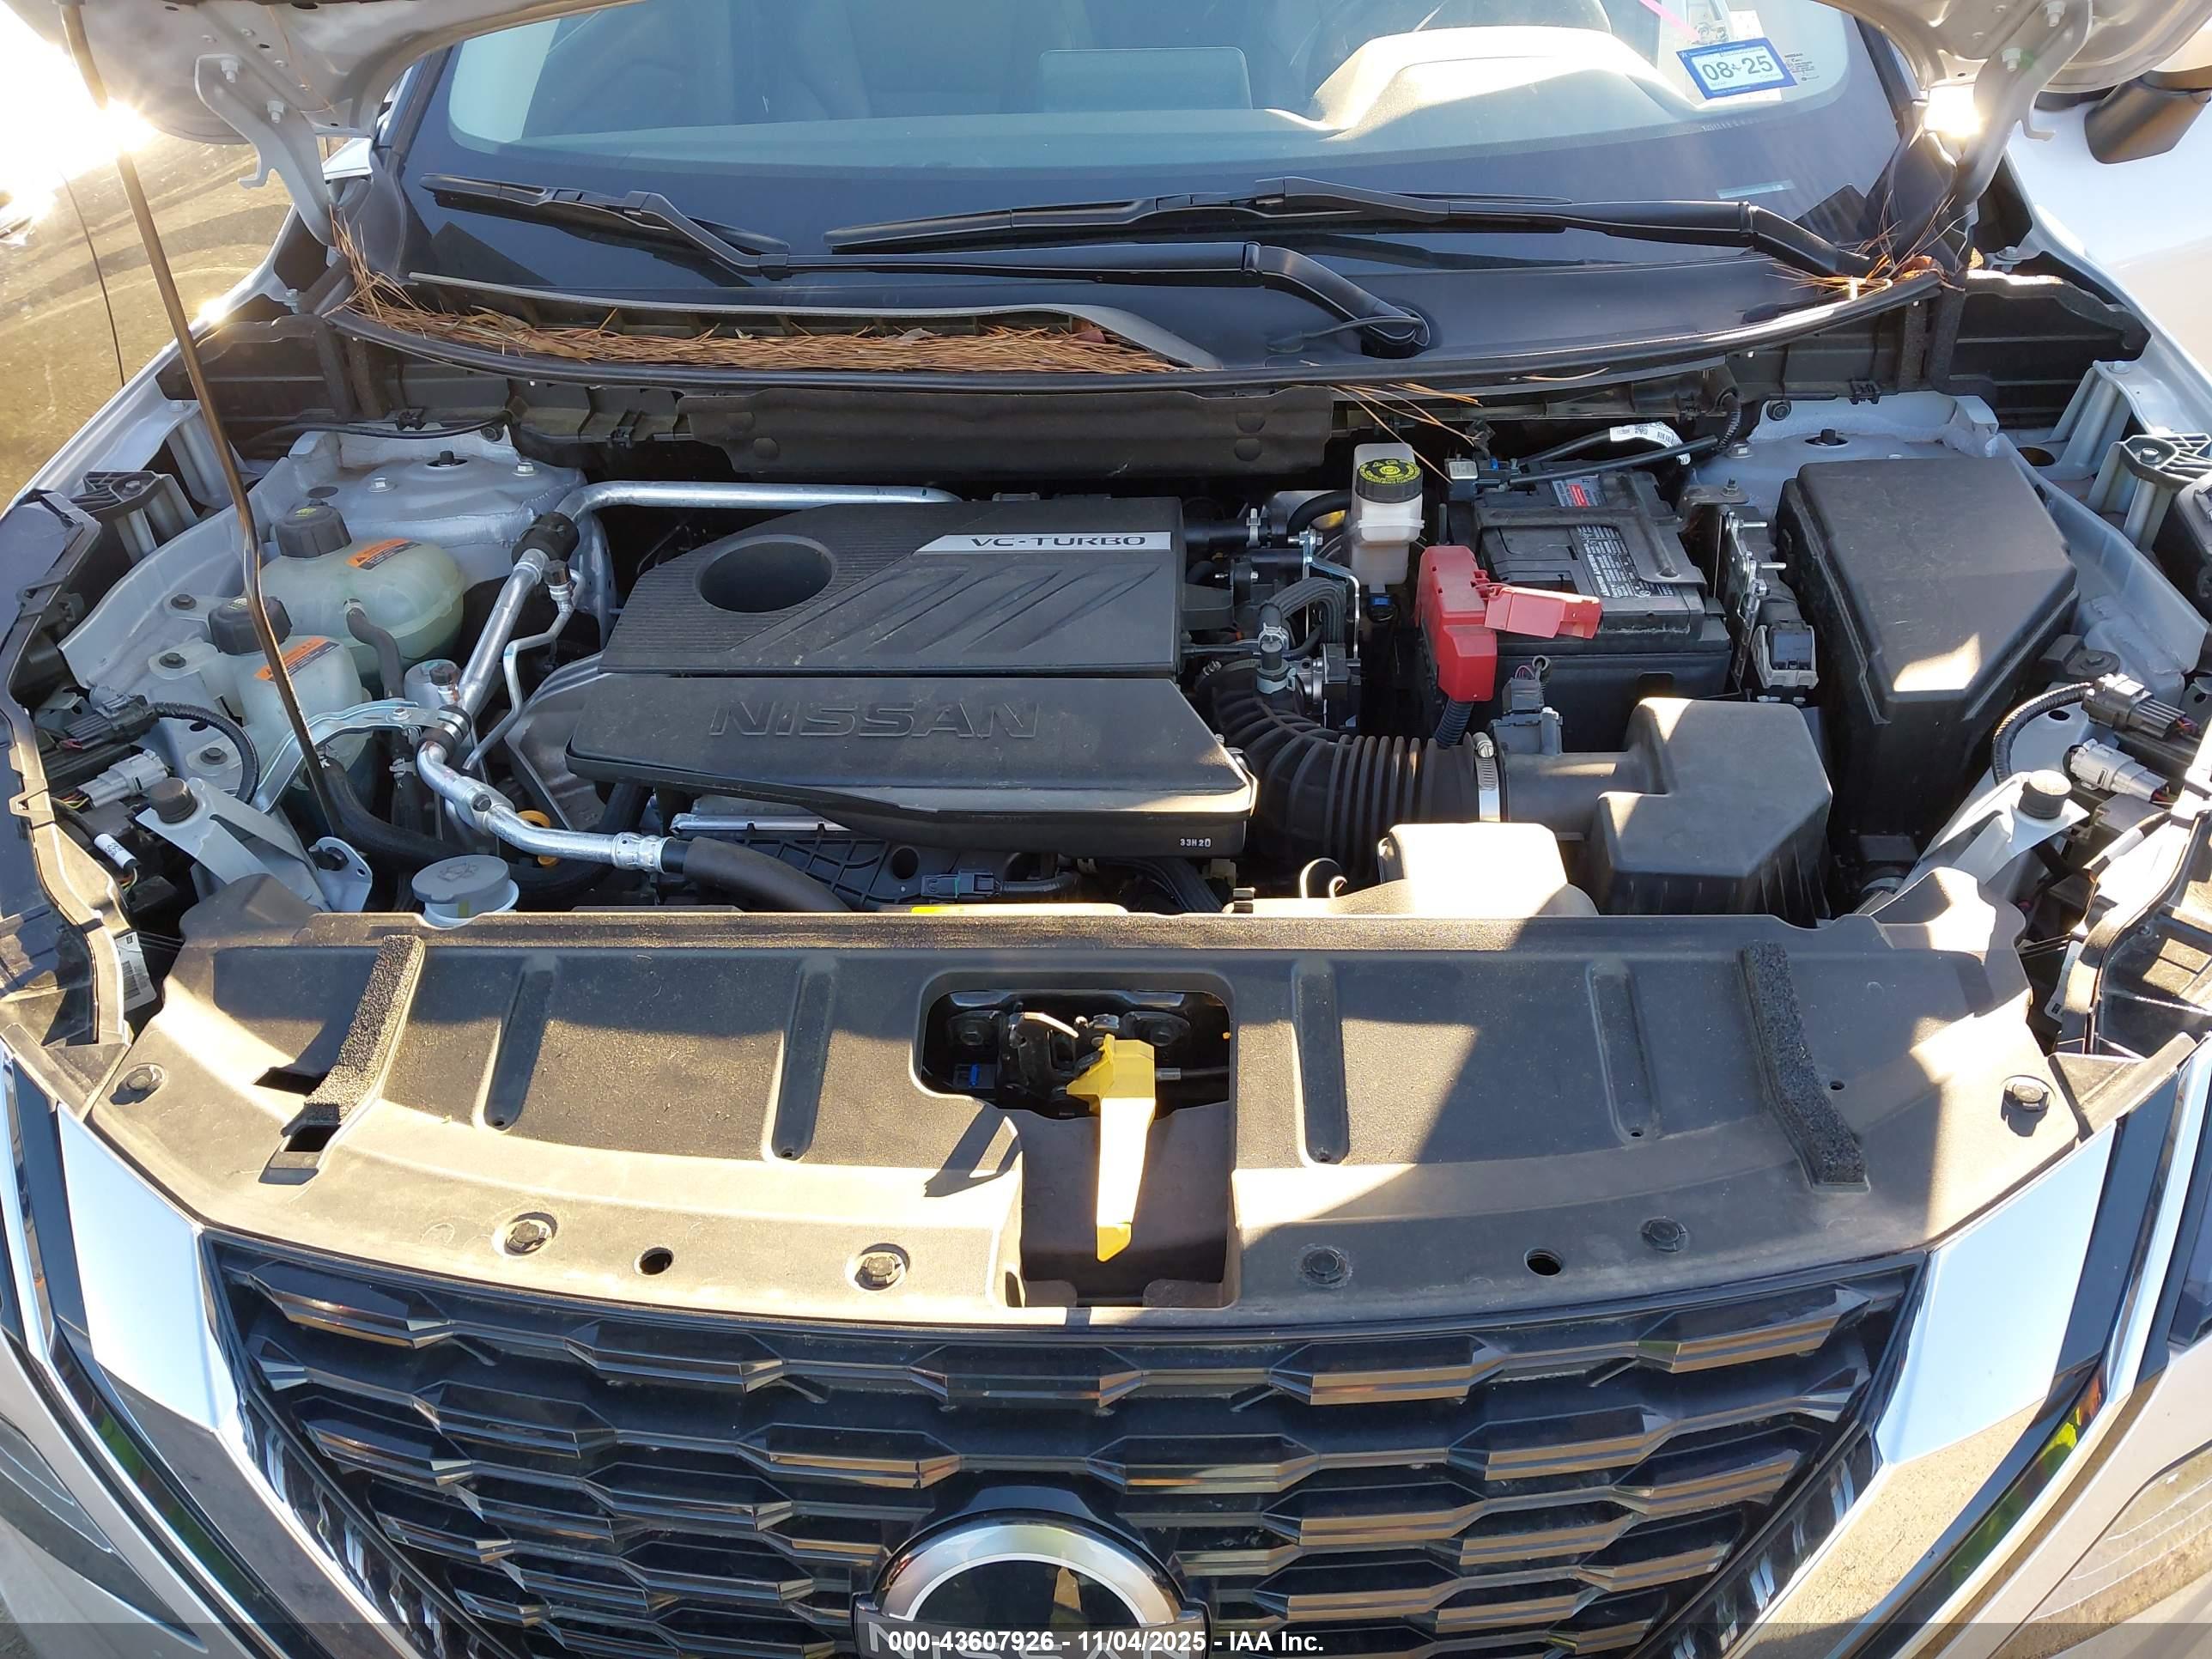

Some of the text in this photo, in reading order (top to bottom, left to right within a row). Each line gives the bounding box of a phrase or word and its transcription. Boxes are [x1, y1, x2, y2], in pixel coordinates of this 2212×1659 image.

[1702, 61, 1735, 81] 08
[1741, 55, 1774, 75] 25
[969, 536, 1146, 548] VC-TURBO
[708, 700, 1040, 739] NISSAN
